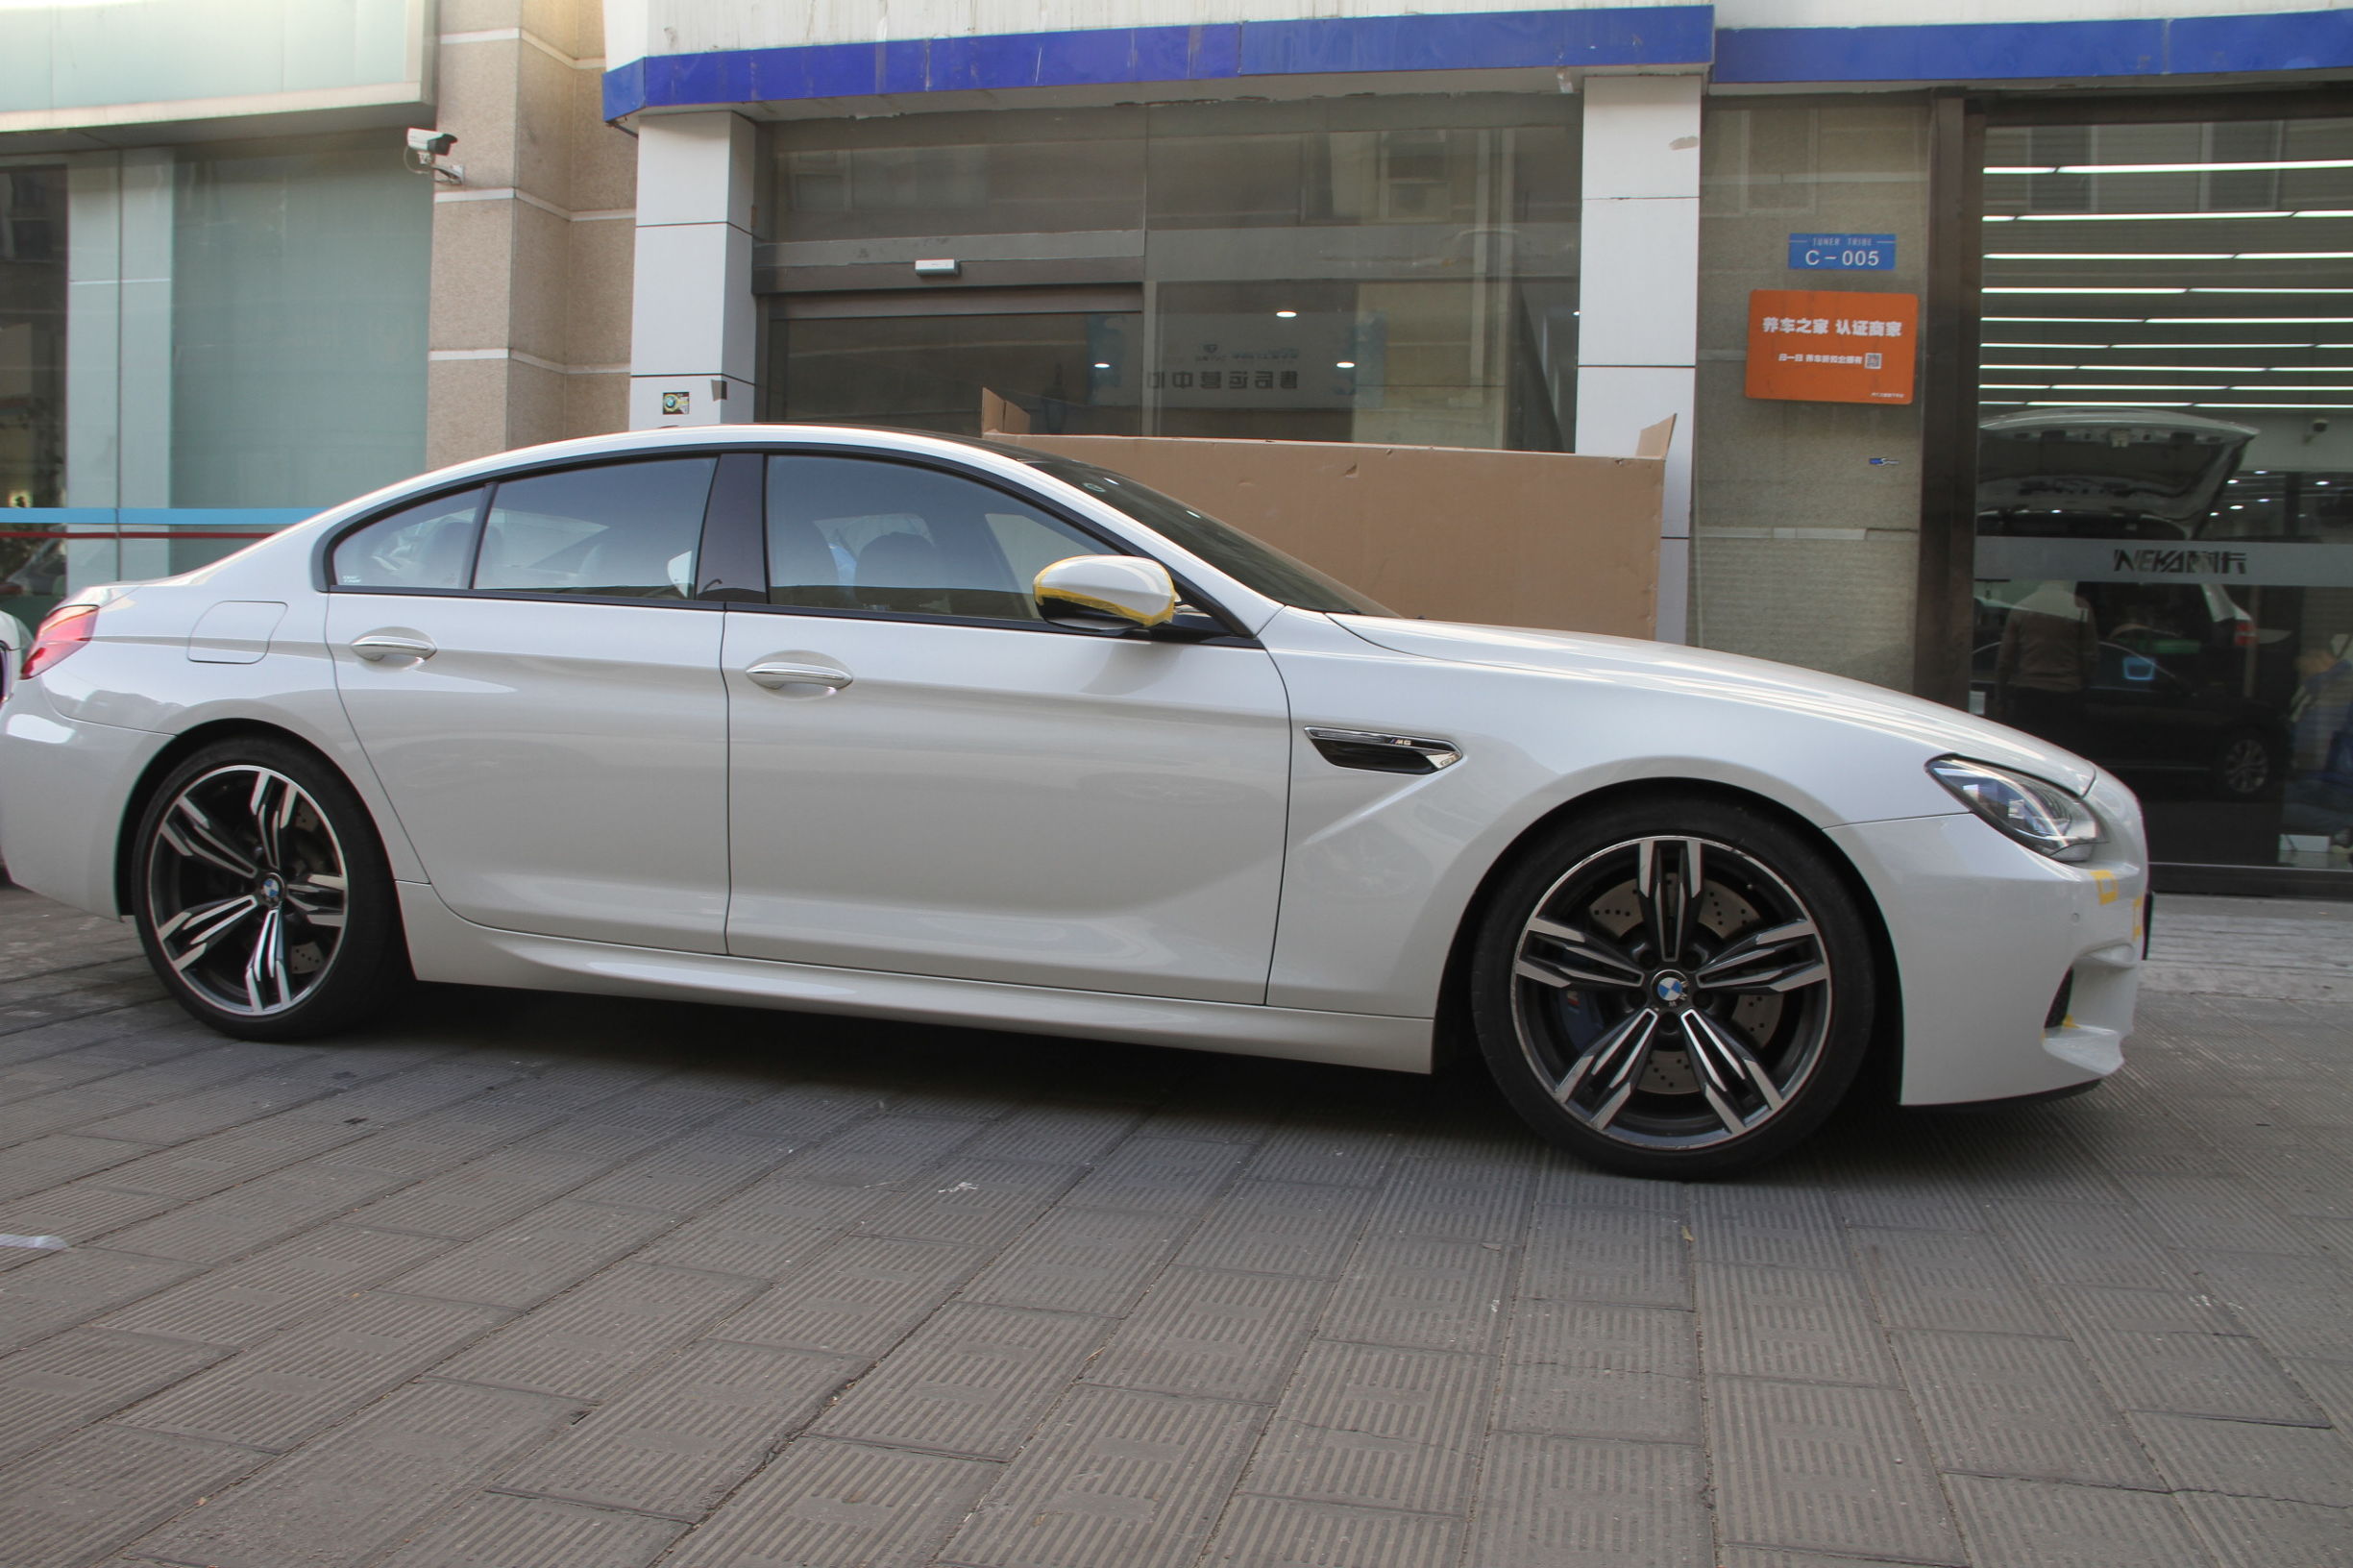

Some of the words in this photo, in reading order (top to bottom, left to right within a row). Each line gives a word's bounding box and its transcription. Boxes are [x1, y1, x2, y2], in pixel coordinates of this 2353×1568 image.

[1805, 250, 1879, 266] C-005
[1762, 316, 1829, 334] 养车之家
[1835, 318, 1903, 337] 认证商家
